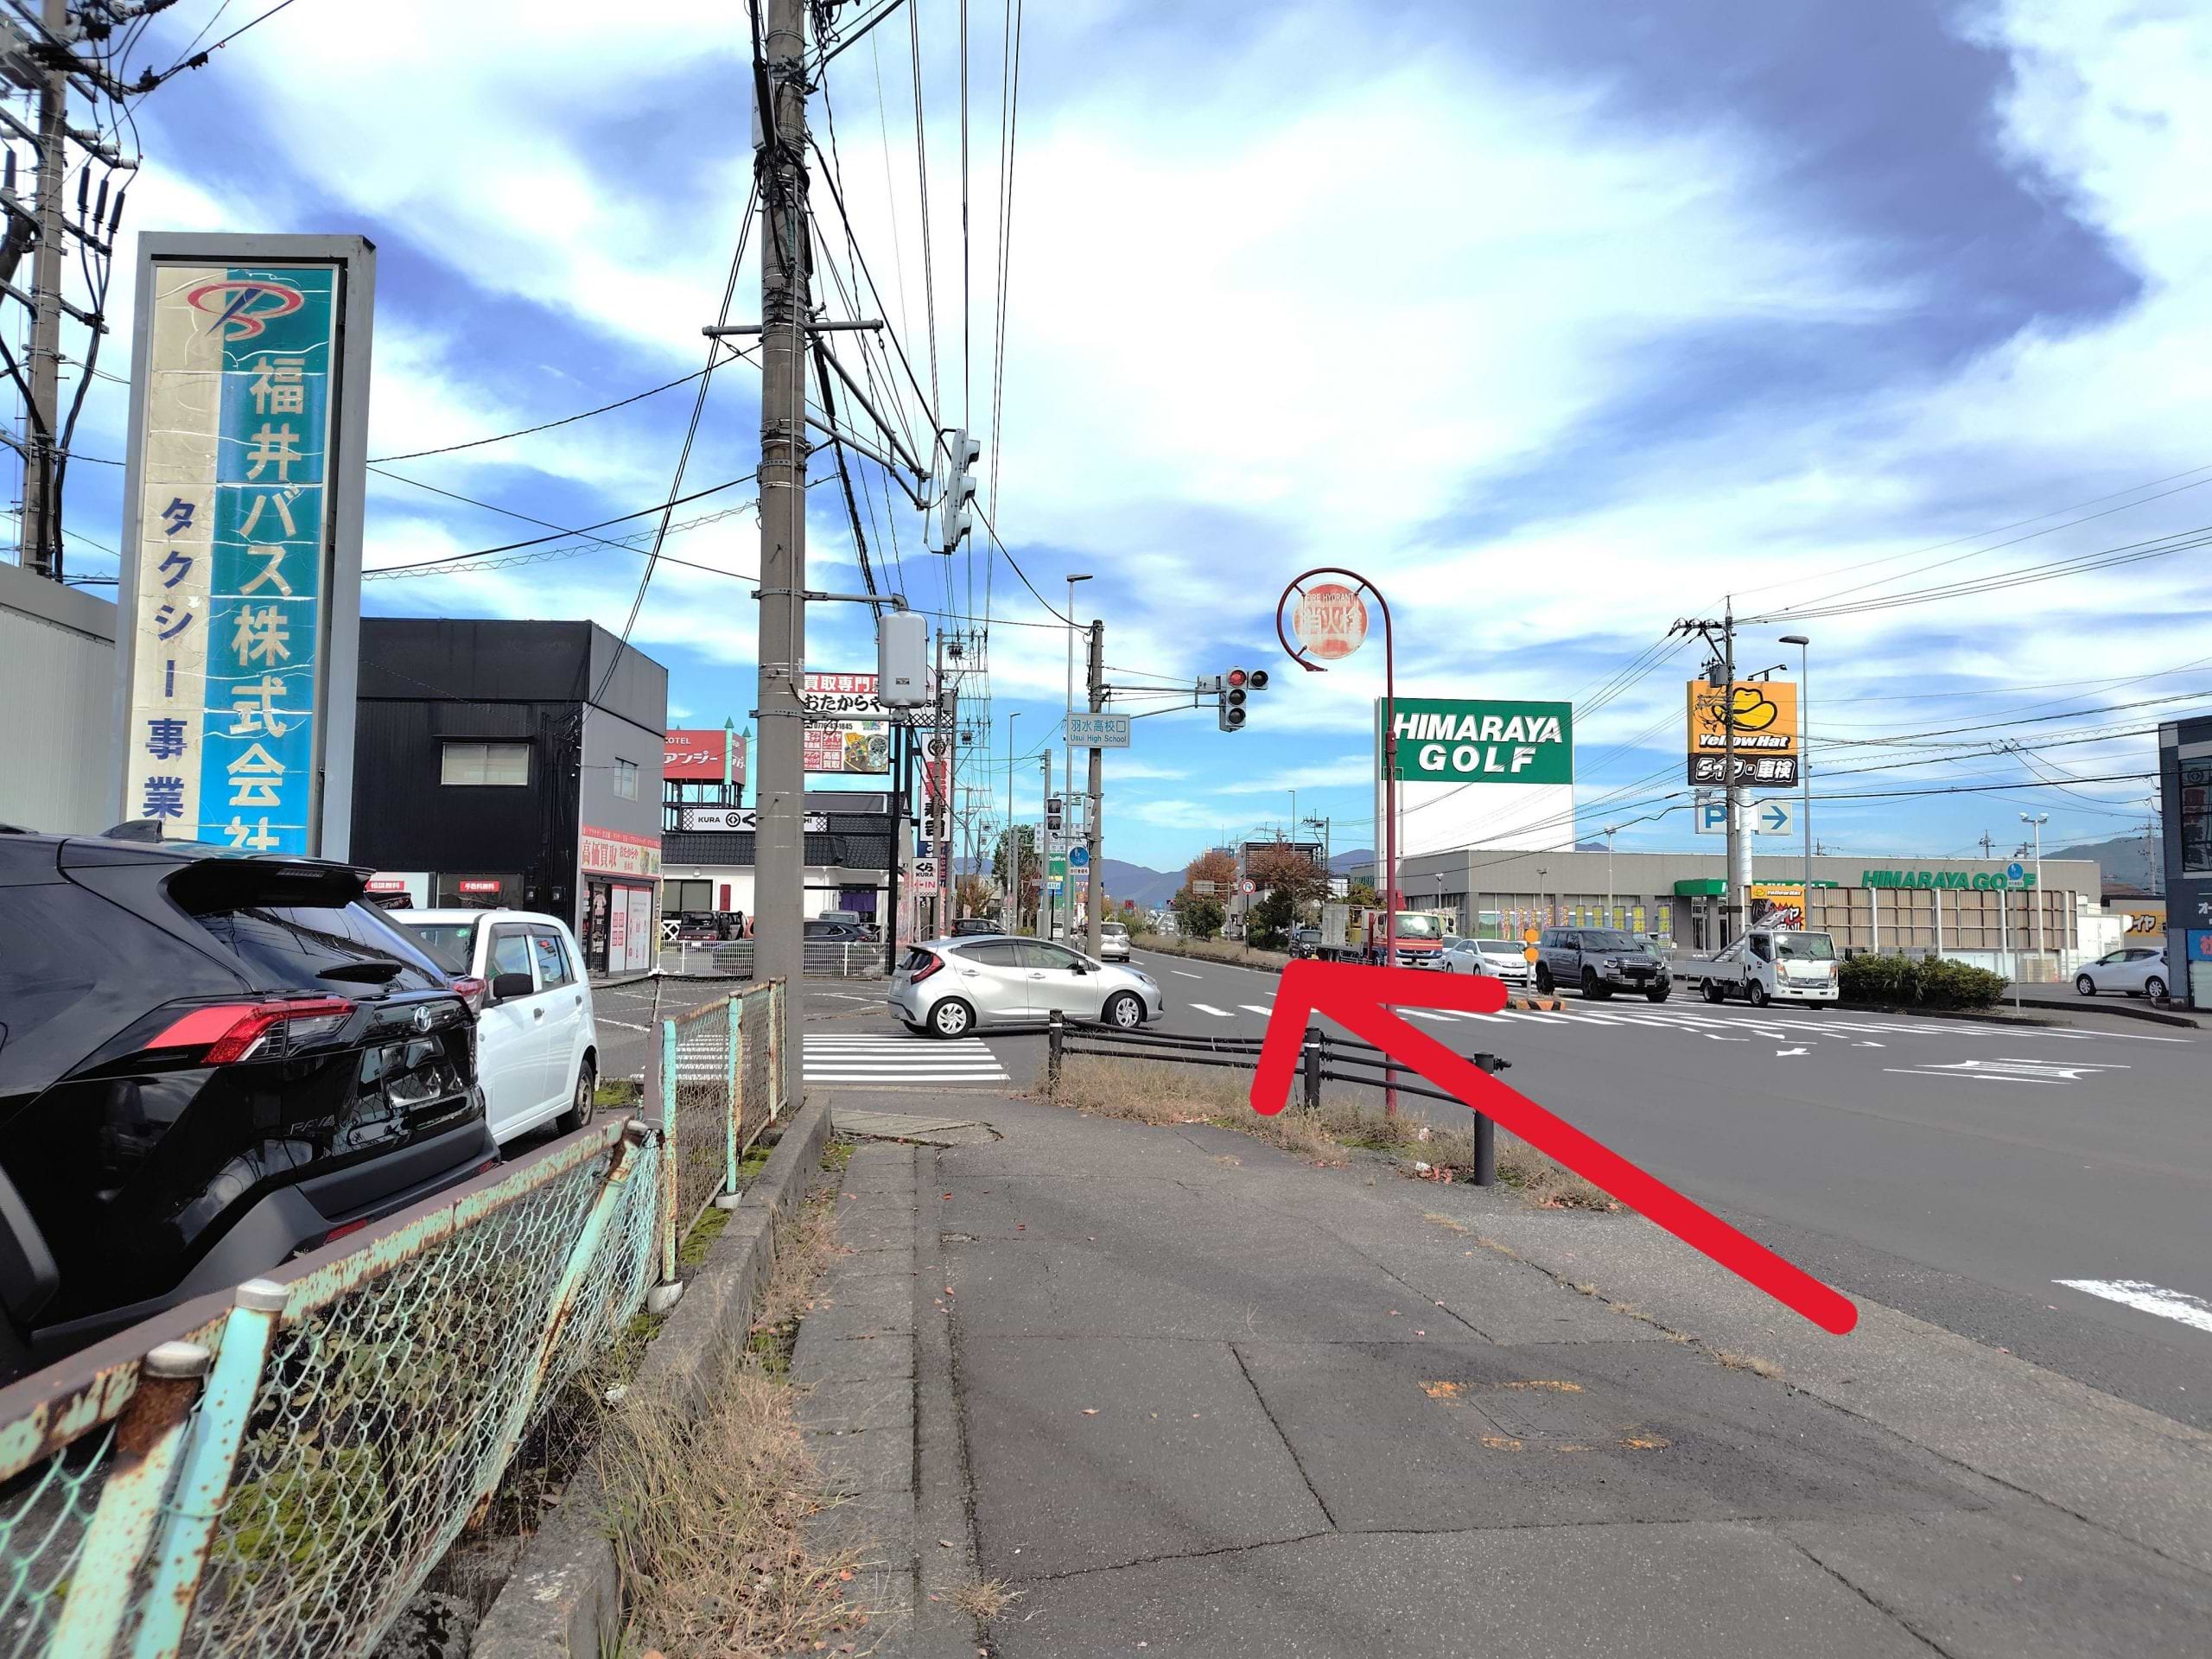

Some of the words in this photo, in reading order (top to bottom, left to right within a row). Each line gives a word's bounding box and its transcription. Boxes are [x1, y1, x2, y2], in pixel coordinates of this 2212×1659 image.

[224, 355, 306, 850] 福井バス株式会社
[1306, 593, 1321, 601] FIRE
[1323, 593, 1354, 602] HYDRANT
[804, 694, 882, 713] おたからや
[1071, 719, 1126, 733] 羽水高校口
[1394, 713, 1562, 743] HIMARAYA
[1087, 734, 1102, 743] High
[1419, 743, 1536, 773] GOLF
[1706, 804, 1726, 829] P
[916, 862, 933, 872] くら
[1862, 870, 1969, 889] HIMARAYA
[1973, 873, 2036, 889] GOF
